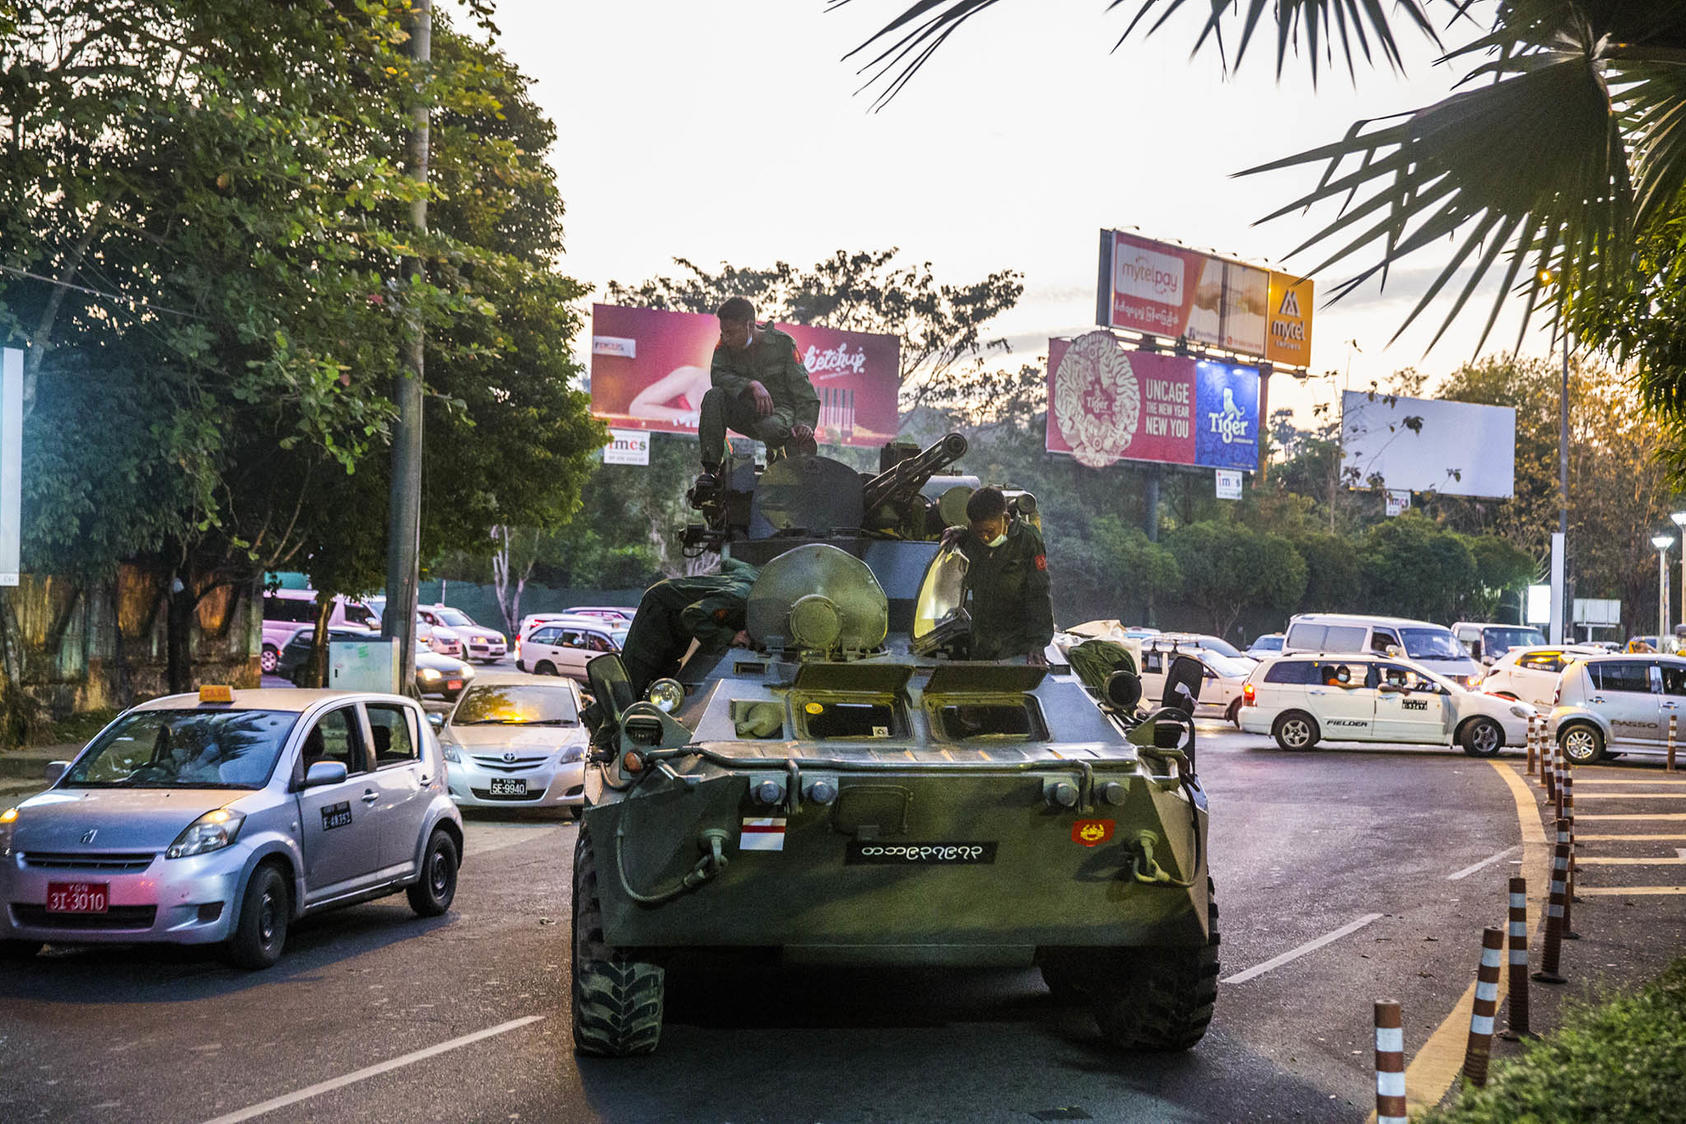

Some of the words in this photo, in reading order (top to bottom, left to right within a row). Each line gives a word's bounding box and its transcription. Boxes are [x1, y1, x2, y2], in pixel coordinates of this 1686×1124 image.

[1121, 262, 1178, 292] mytelpay
[1271, 319, 1305, 341] mytel
[1145, 378, 1190, 405] UNCAGE
[1145, 401, 1157, 415] THE
[1158, 403, 1172, 416] NEW
[1174, 405, 1190, 418] YEAR
[1145, 415, 1168, 437] NEW
[1170, 418, 1190, 439] YOU
[1208, 411, 1249, 444] Tiger
[1326, 719, 1368, 728] FIELDER
